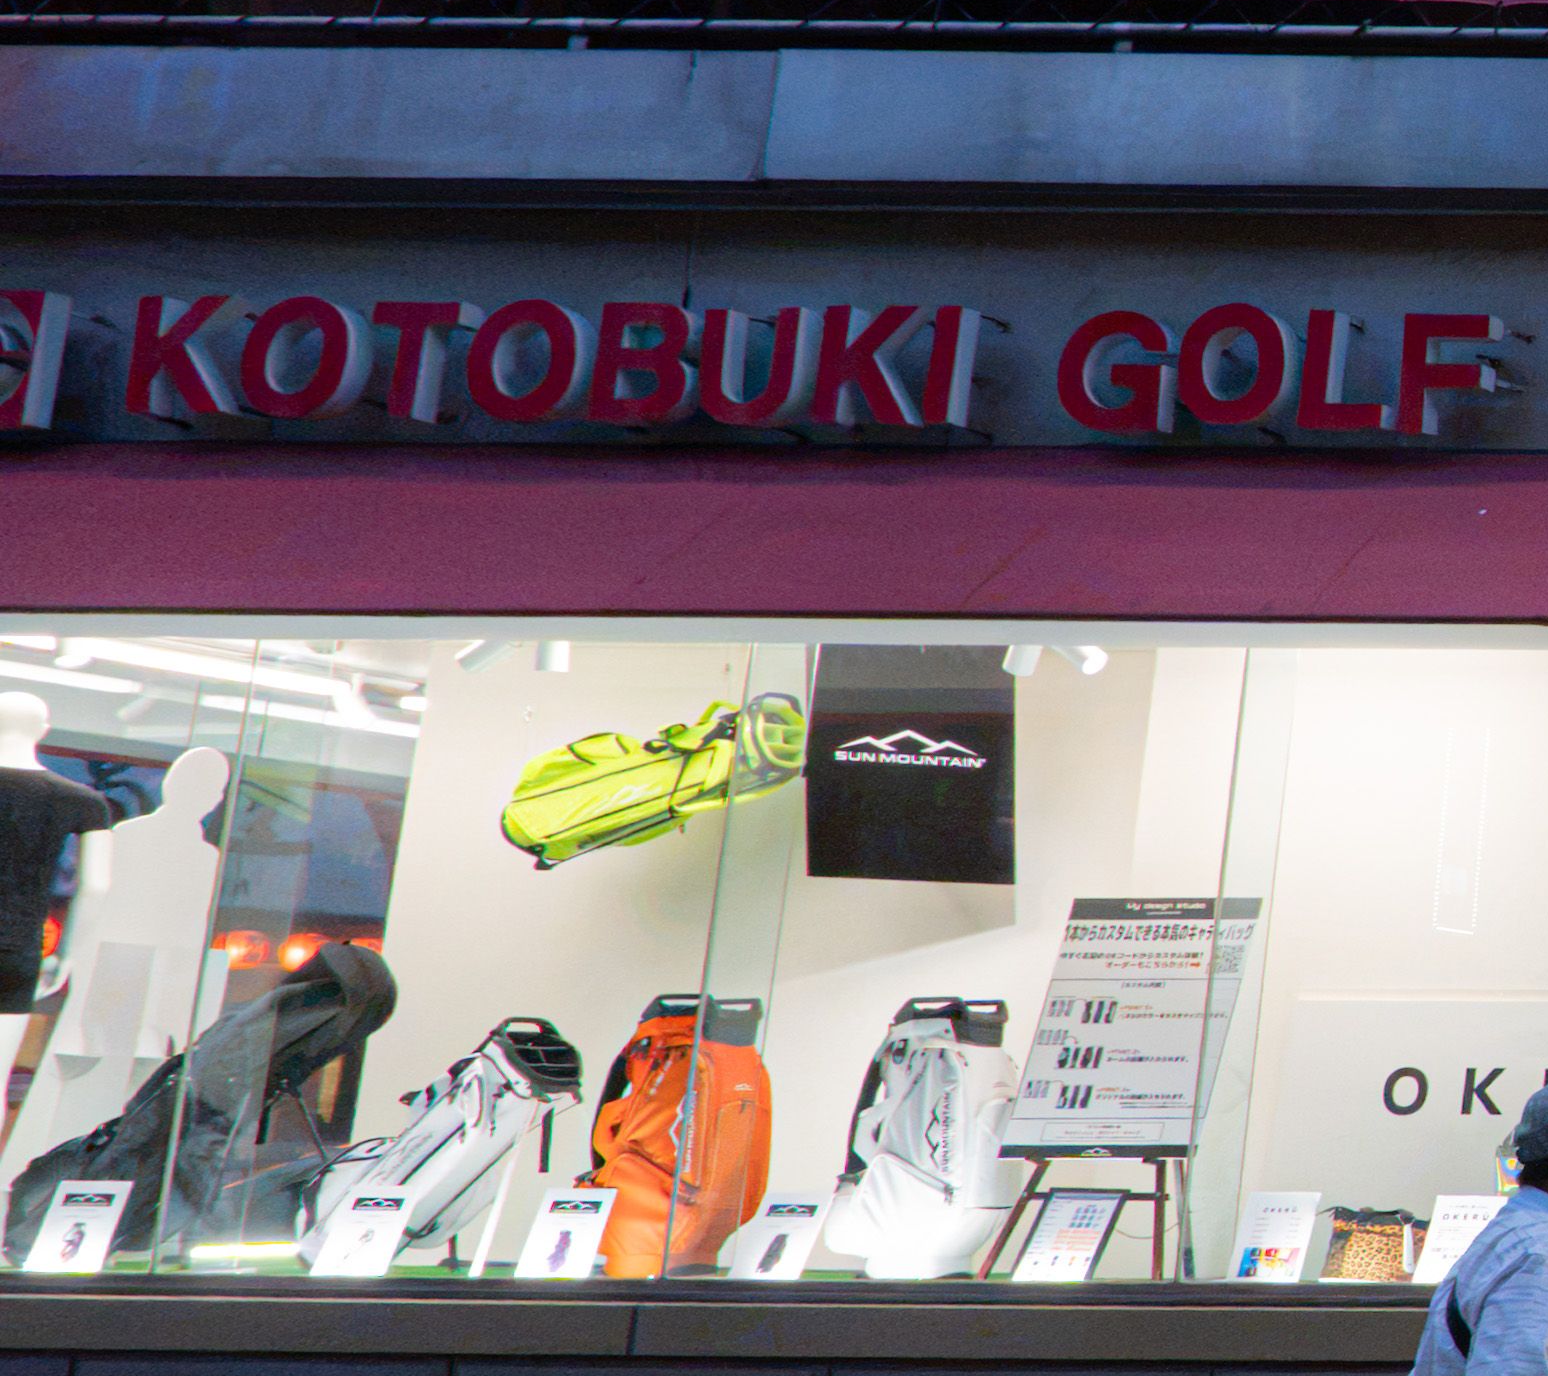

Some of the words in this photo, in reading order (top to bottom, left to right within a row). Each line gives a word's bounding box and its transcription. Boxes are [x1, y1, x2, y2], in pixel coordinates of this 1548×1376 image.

[125, 292, 985, 432] KOTOBUKI
[1056, 302, 1502, 437] GOLF
[834, 750, 877, 763] SUN
[878, 752, 984, 769] MOUNTAIN
